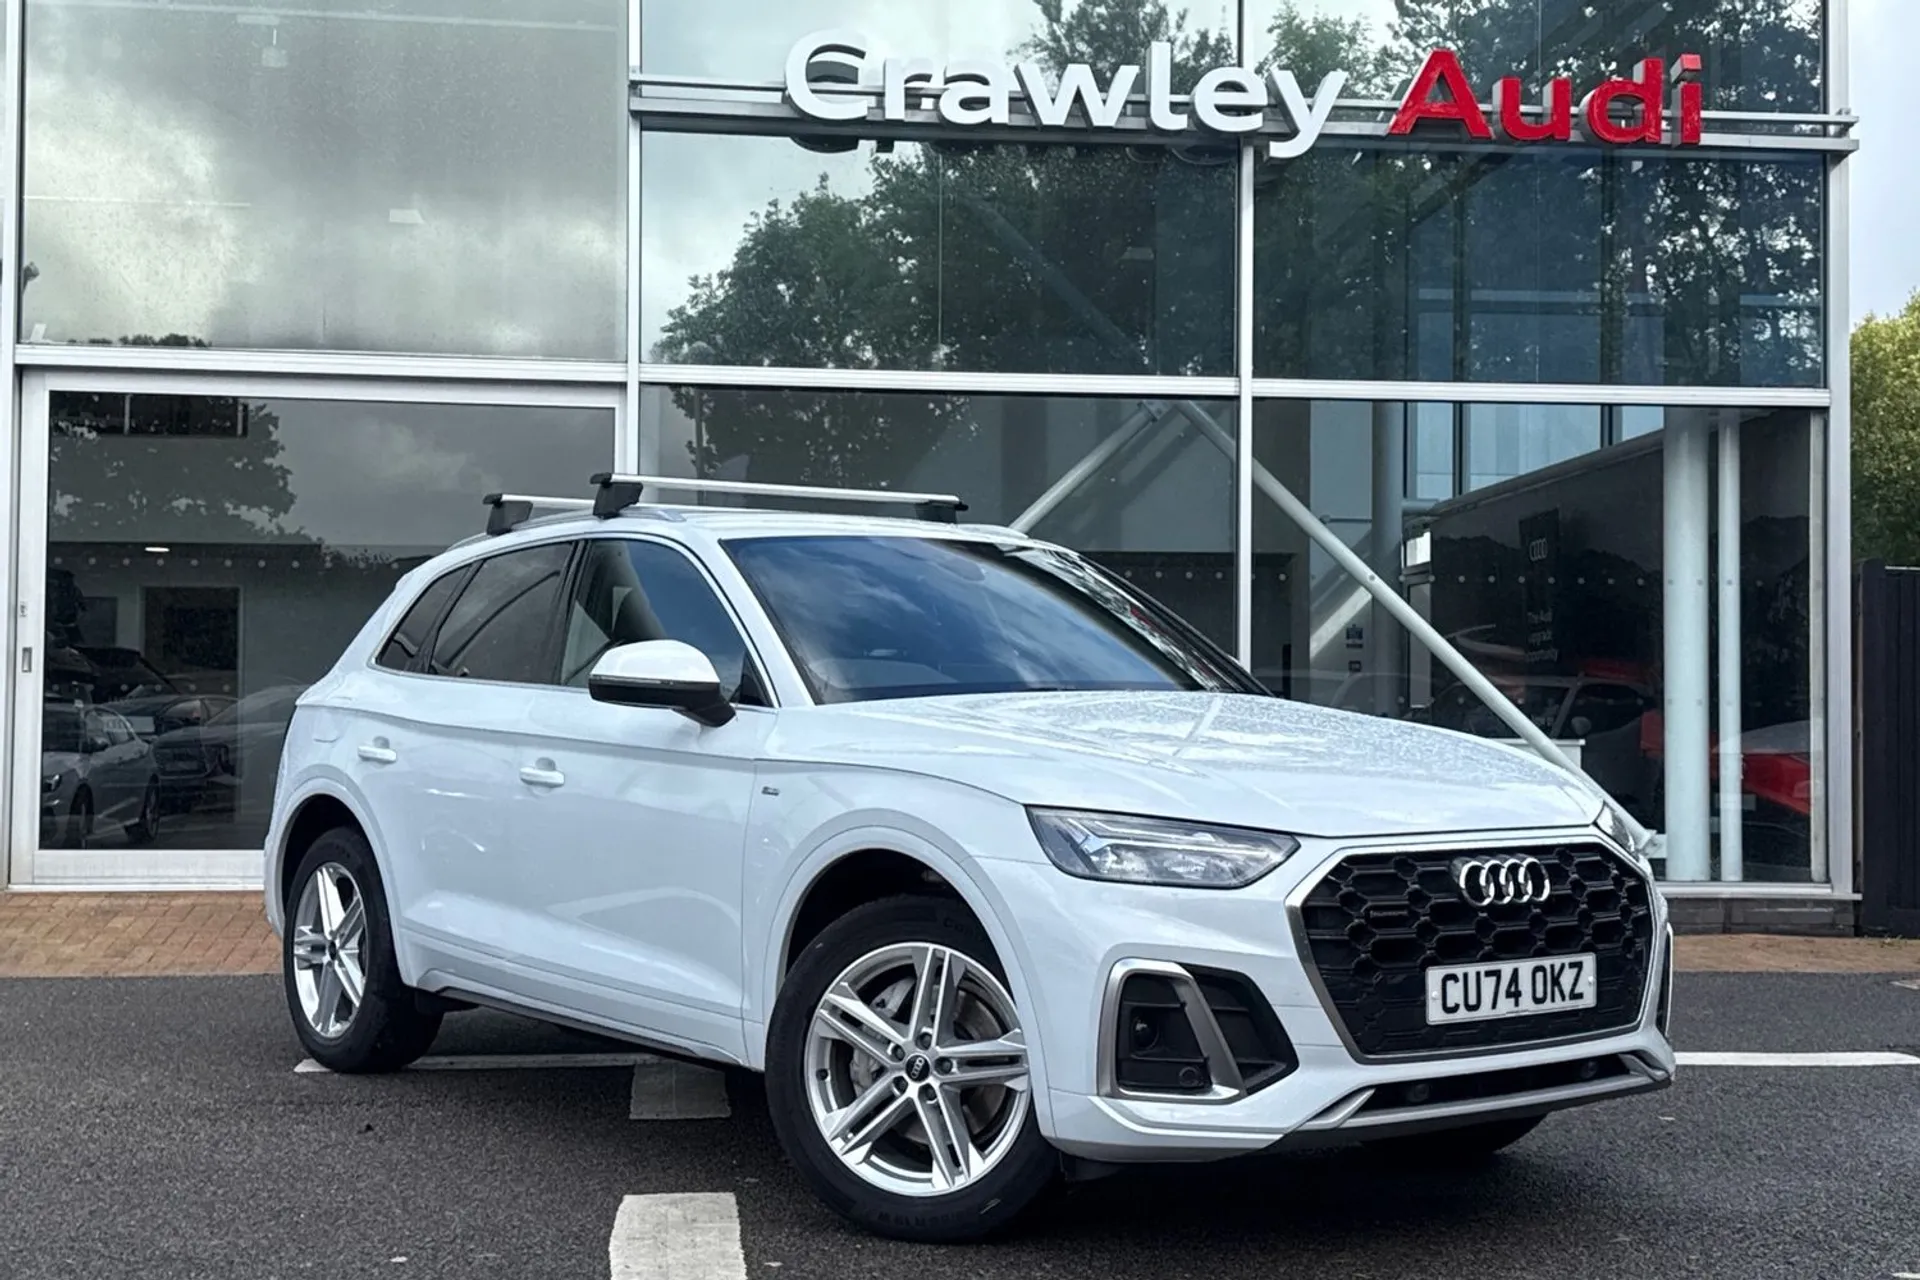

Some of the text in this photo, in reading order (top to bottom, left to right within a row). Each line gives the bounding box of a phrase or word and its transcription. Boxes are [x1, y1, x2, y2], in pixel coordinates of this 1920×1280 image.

[785, 27, 1701, 158] Crawley Audi
[1441, 960, 1584, 1014] CU74 OKZ
